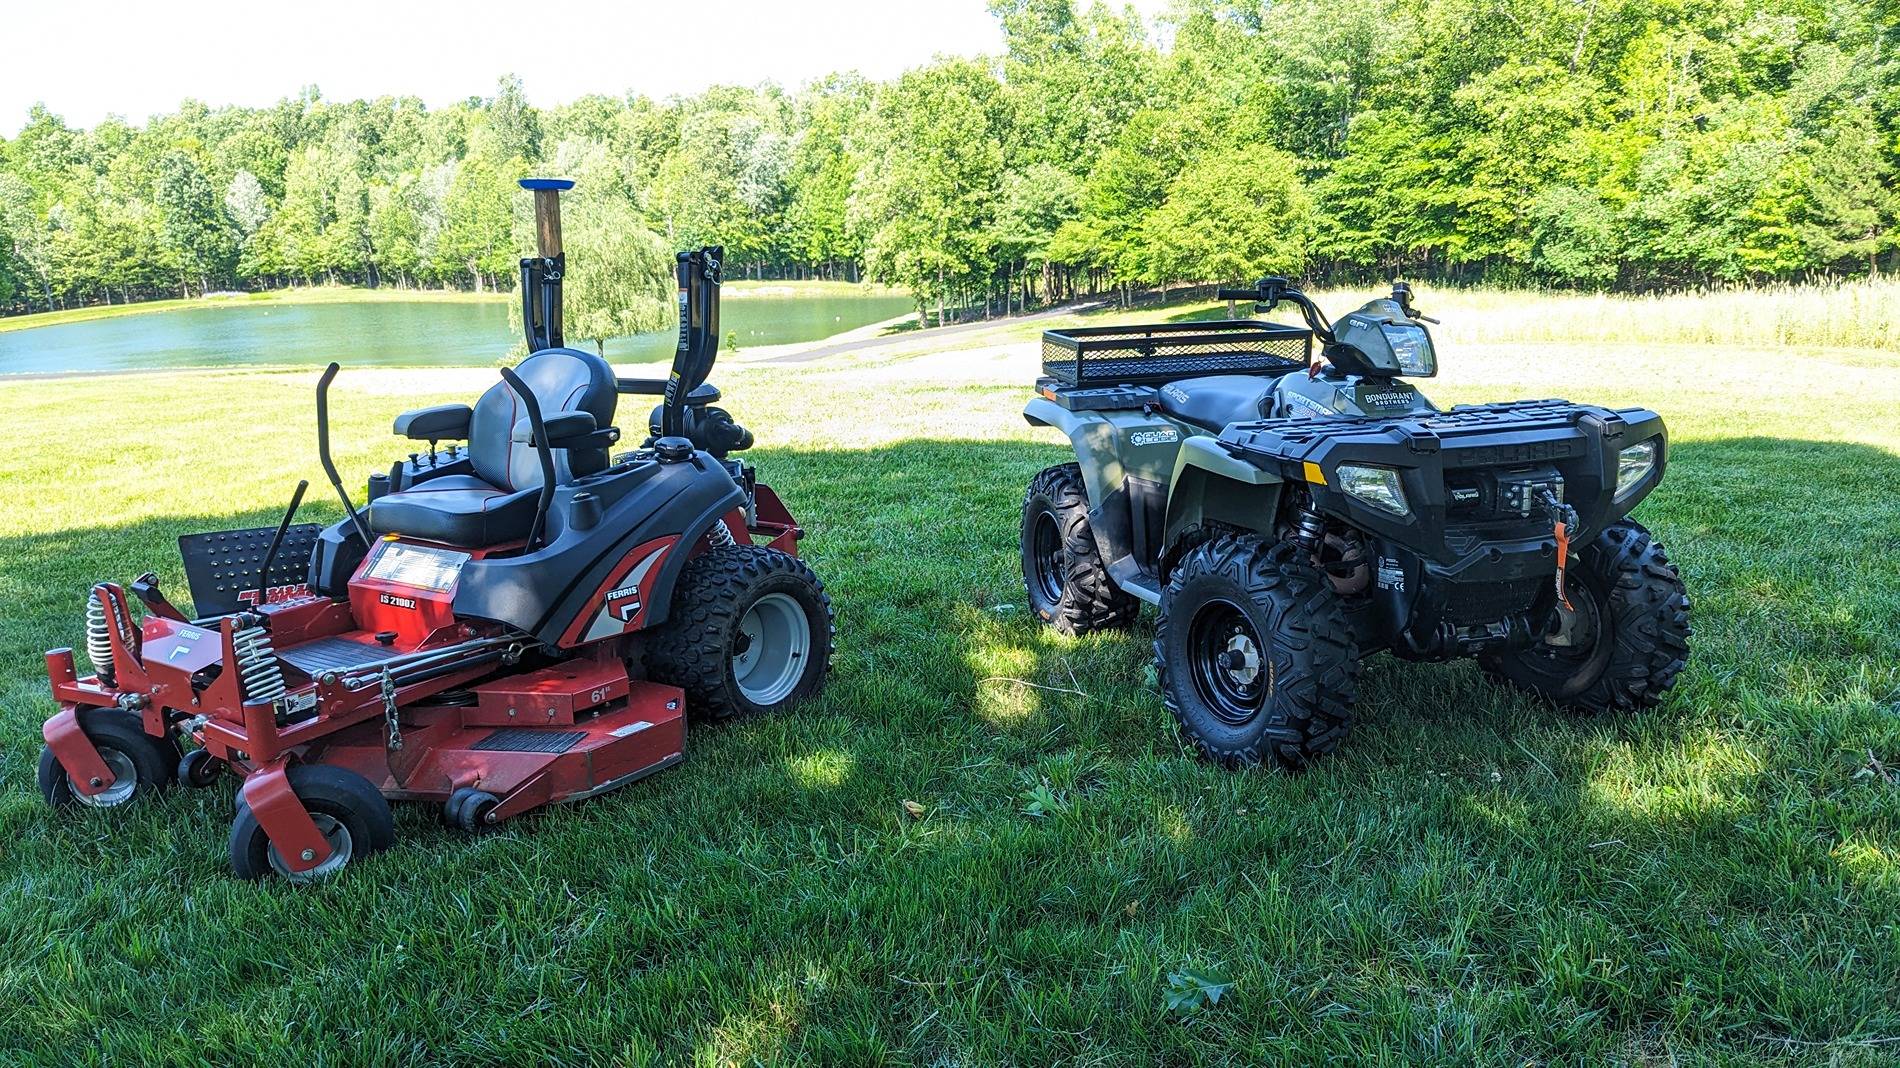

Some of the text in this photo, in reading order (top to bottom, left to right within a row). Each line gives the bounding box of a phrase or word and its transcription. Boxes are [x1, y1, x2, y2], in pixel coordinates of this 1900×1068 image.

[1364, 392, 1414, 404] BONDURANT
[606, 586, 638, 601] FERRIS
[390, 596, 416, 609] 2100Z
